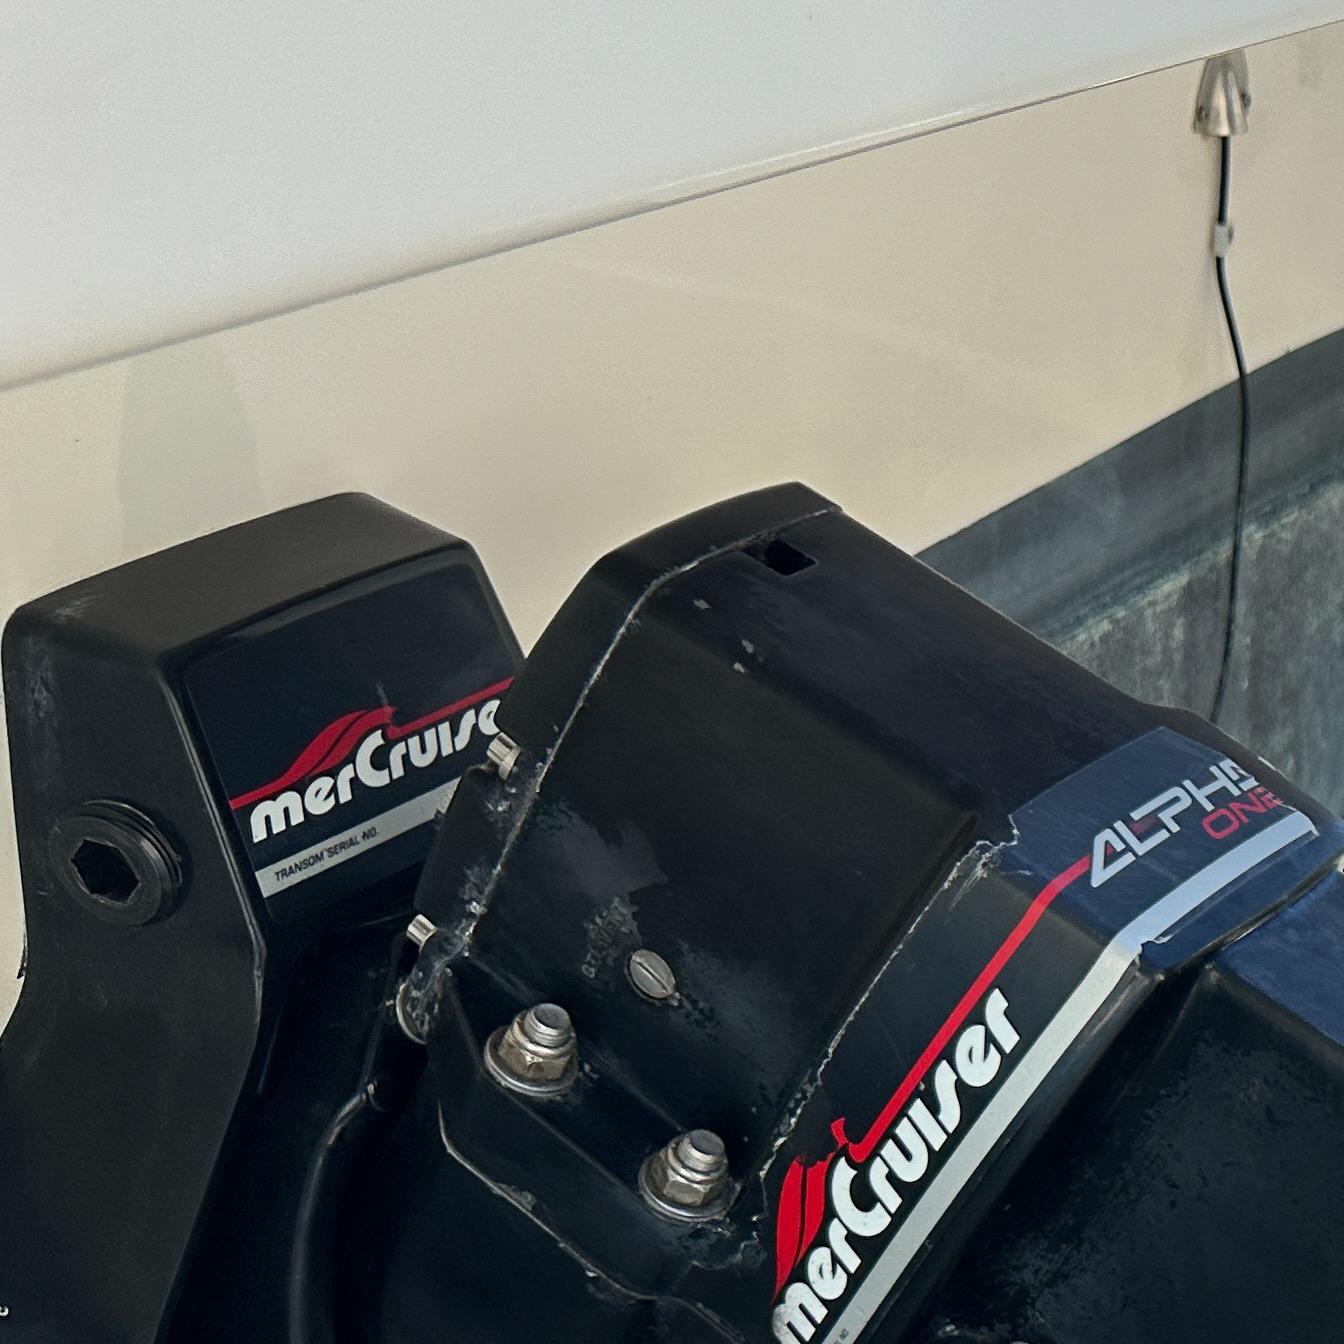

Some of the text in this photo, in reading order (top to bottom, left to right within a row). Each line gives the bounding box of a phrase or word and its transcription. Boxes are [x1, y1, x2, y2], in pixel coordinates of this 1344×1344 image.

[250, 699, 501, 843] merCruise
[274, 850, 325, 881] TRANSOM
[326, 836, 360, 858] SERIAL
